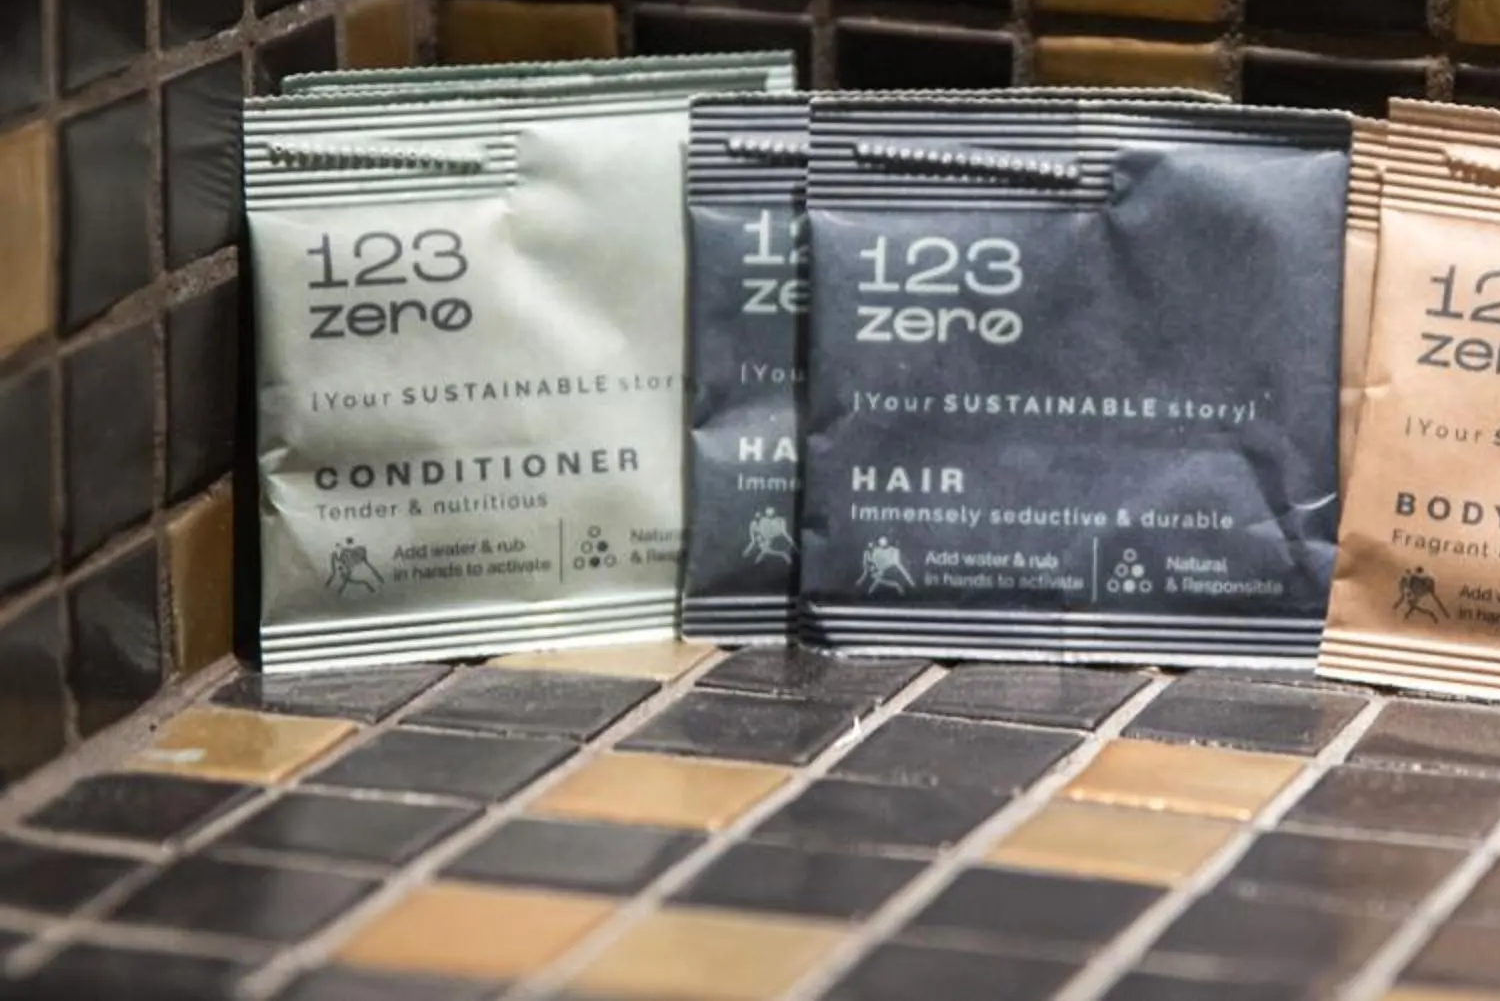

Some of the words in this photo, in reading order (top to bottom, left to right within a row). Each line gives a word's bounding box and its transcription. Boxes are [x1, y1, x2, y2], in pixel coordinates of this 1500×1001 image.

[307, 228, 469, 290] 123
[856, 235, 1024, 296] 123
[742, 279, 810, 313] ze
[402, 375, 609, 405] SUSTAINABLE
[943, 393, 1157, 419] SUSTAINABLE
[738, 436, 799, 463] HA
[315, 448, 640, 491] CONDITIONER
[851, 466, 966, 494] HAIR
[316, 499, 399, 522] Tender
[408, 498, 423, 517] &
[433, 492, 550, 515] nutritious
[851, 502, 982, 528] Immensely
[990, 504, 1108, 527] seductive
[1116, 507, 1132, 528] &
[1139, 508, 1235, 530] durable
[393, 543, 428, 561] Add
[431, 541, 478, 560] water
[480, 539, 493, 556] &
[497, 537, 526, 553] rub
[1391, 527, 1489, 560] Fragrant
[393, 567, 409, 582] in
[411, 562, 462, 580] hands
[466, 560, 483, 578] to
[486, 556, 552, 576] activate
[925, 551, 960, 567] Add
[962, 552, 1012, 568] water
[1013, 551, 1026, 568] &
[1029, 551, 1060, 570] rub
[1166, 555, 1228, 574] Natural
[943, 571, 993, 589] hands
[997, 573, 1014, 589] to
[1019, 573, 1085, 591] activate
[1182, 577, 1284, 596] Responsible
[1459, 584, 1493, 602] Add
[1458, 605, 1473, 621] in
